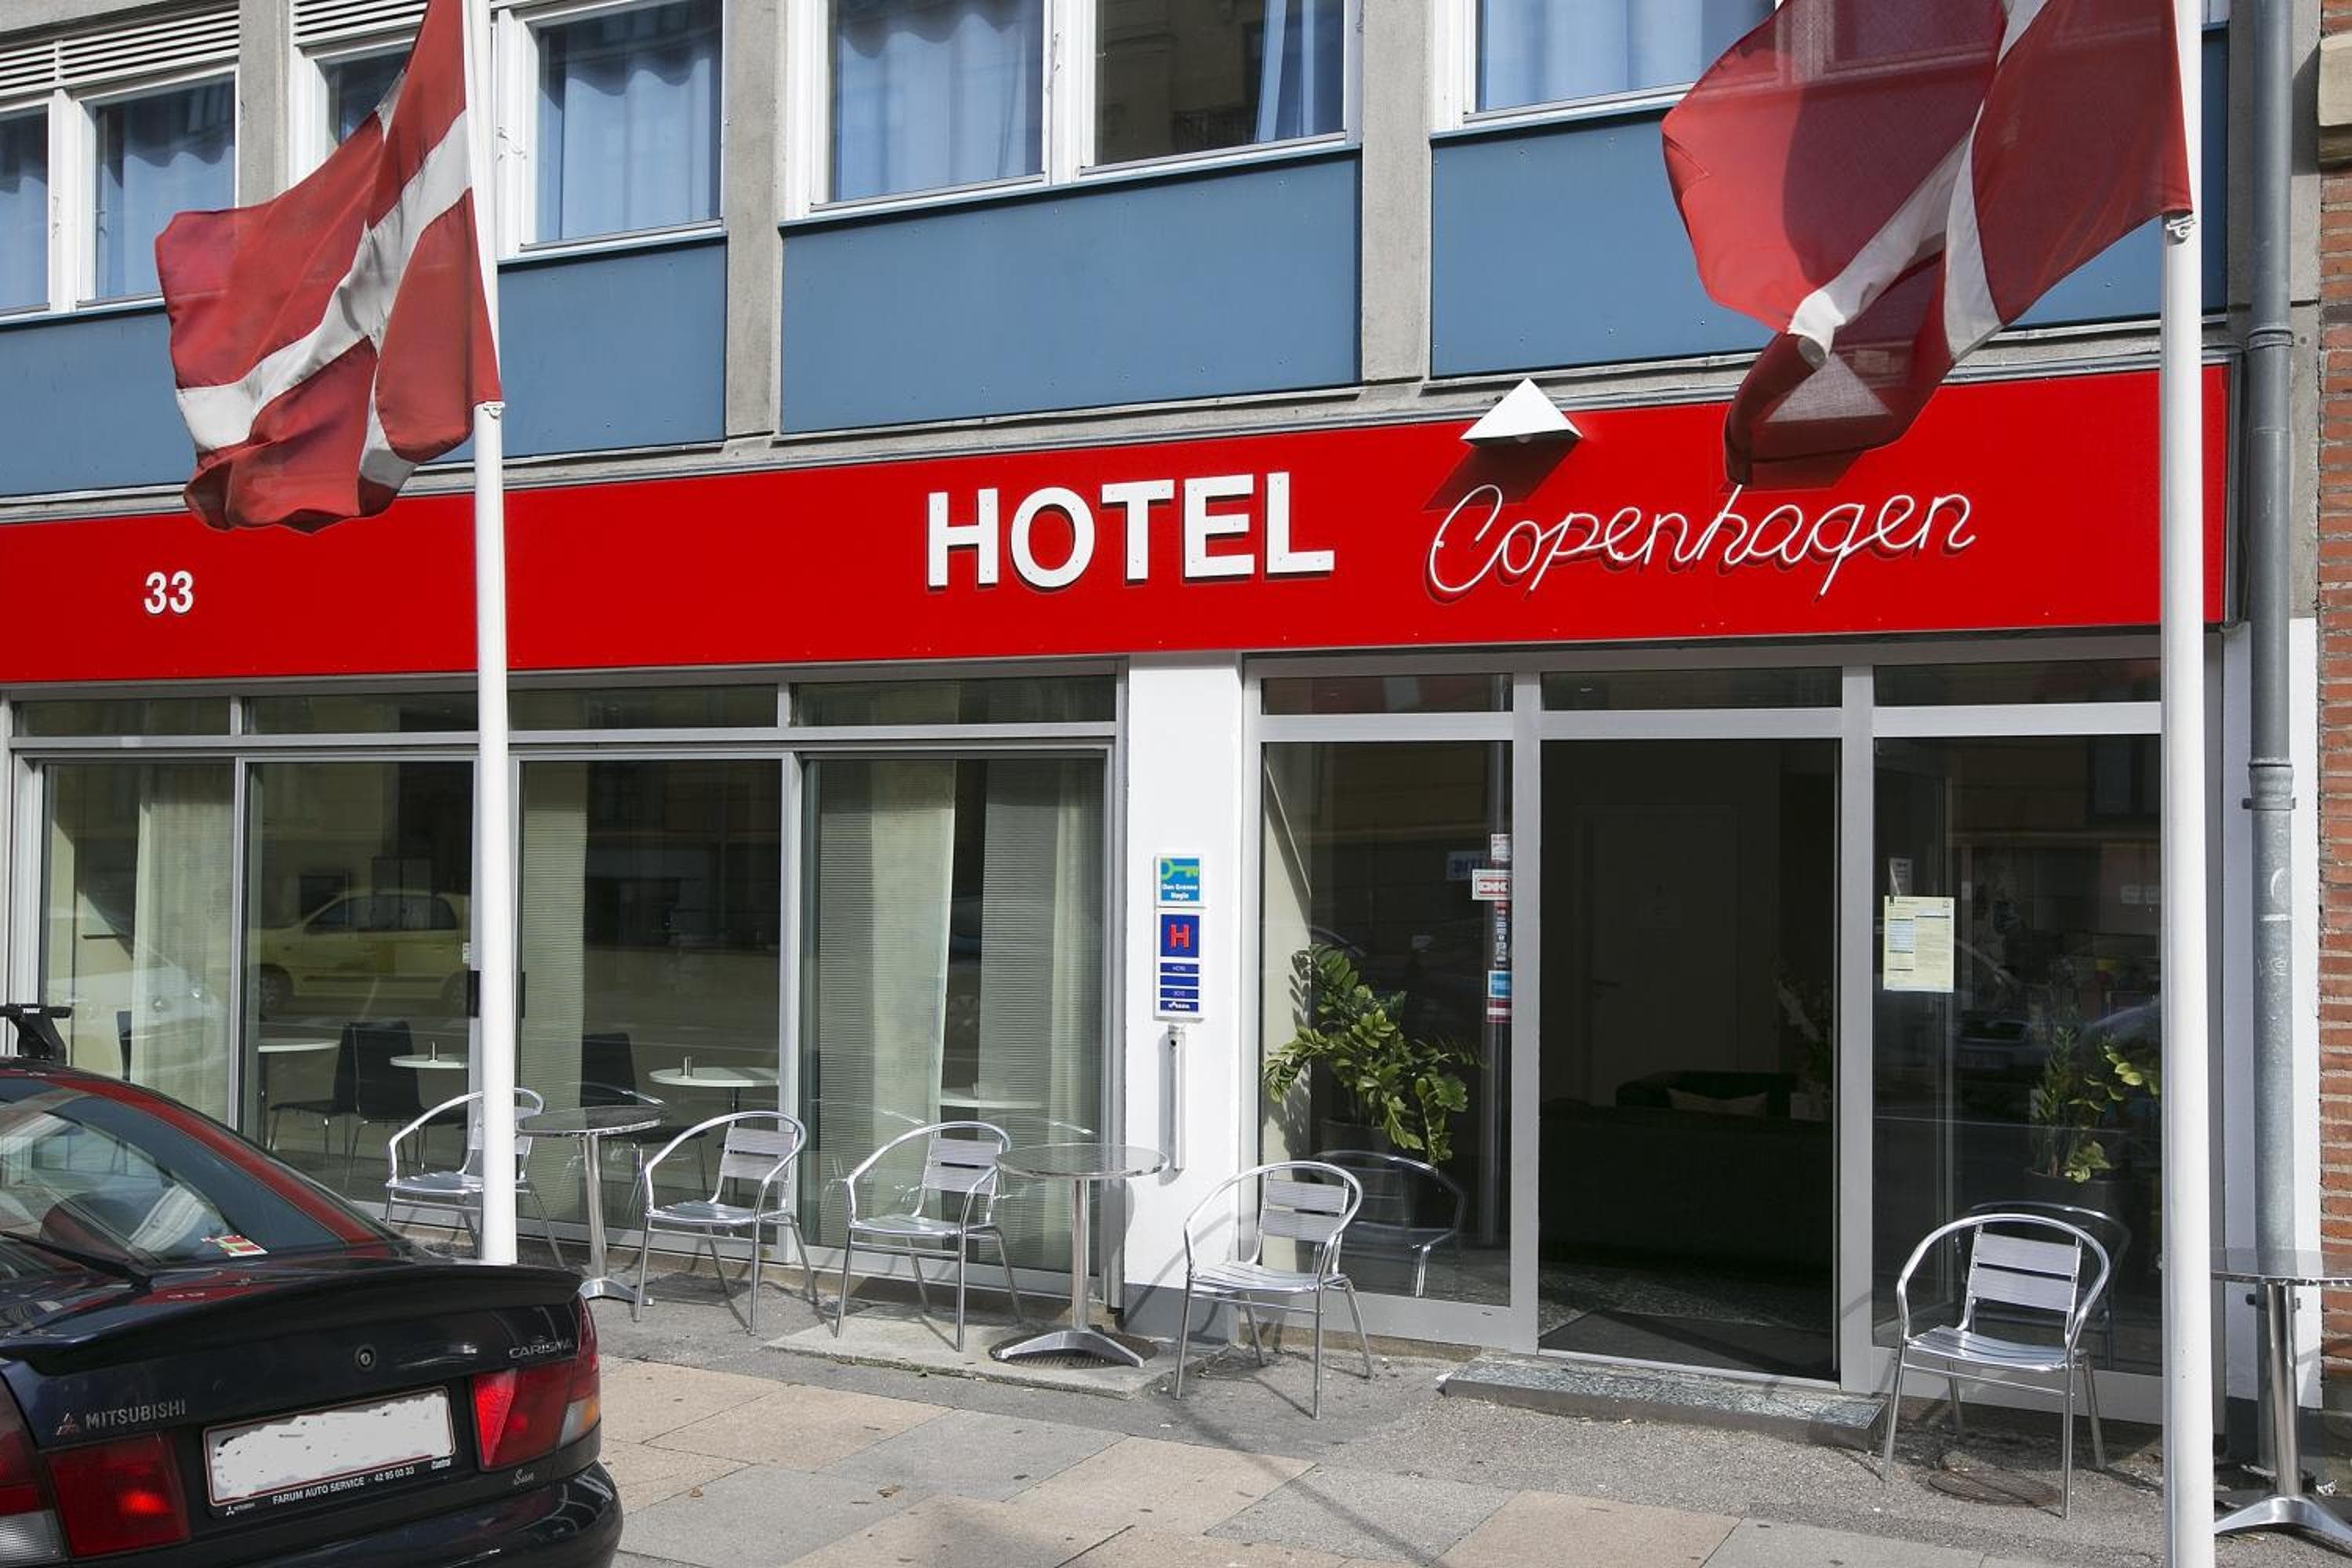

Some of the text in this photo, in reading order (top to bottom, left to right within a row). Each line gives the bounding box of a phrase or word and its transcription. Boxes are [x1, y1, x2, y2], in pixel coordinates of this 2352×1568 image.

[927, 471, 1976, 596] HOTEL Copenhagen
[144, 570, 194, 615] 33
[1169, 923, 1190, 949] H
[85, 1399, 186, 1430] MITSUBISHI
[273, 1488, 303, 1504] FARUM
[305, 1484, 328, 1497] AUTO
[330, 1477, 365, 1493] SERVICE
